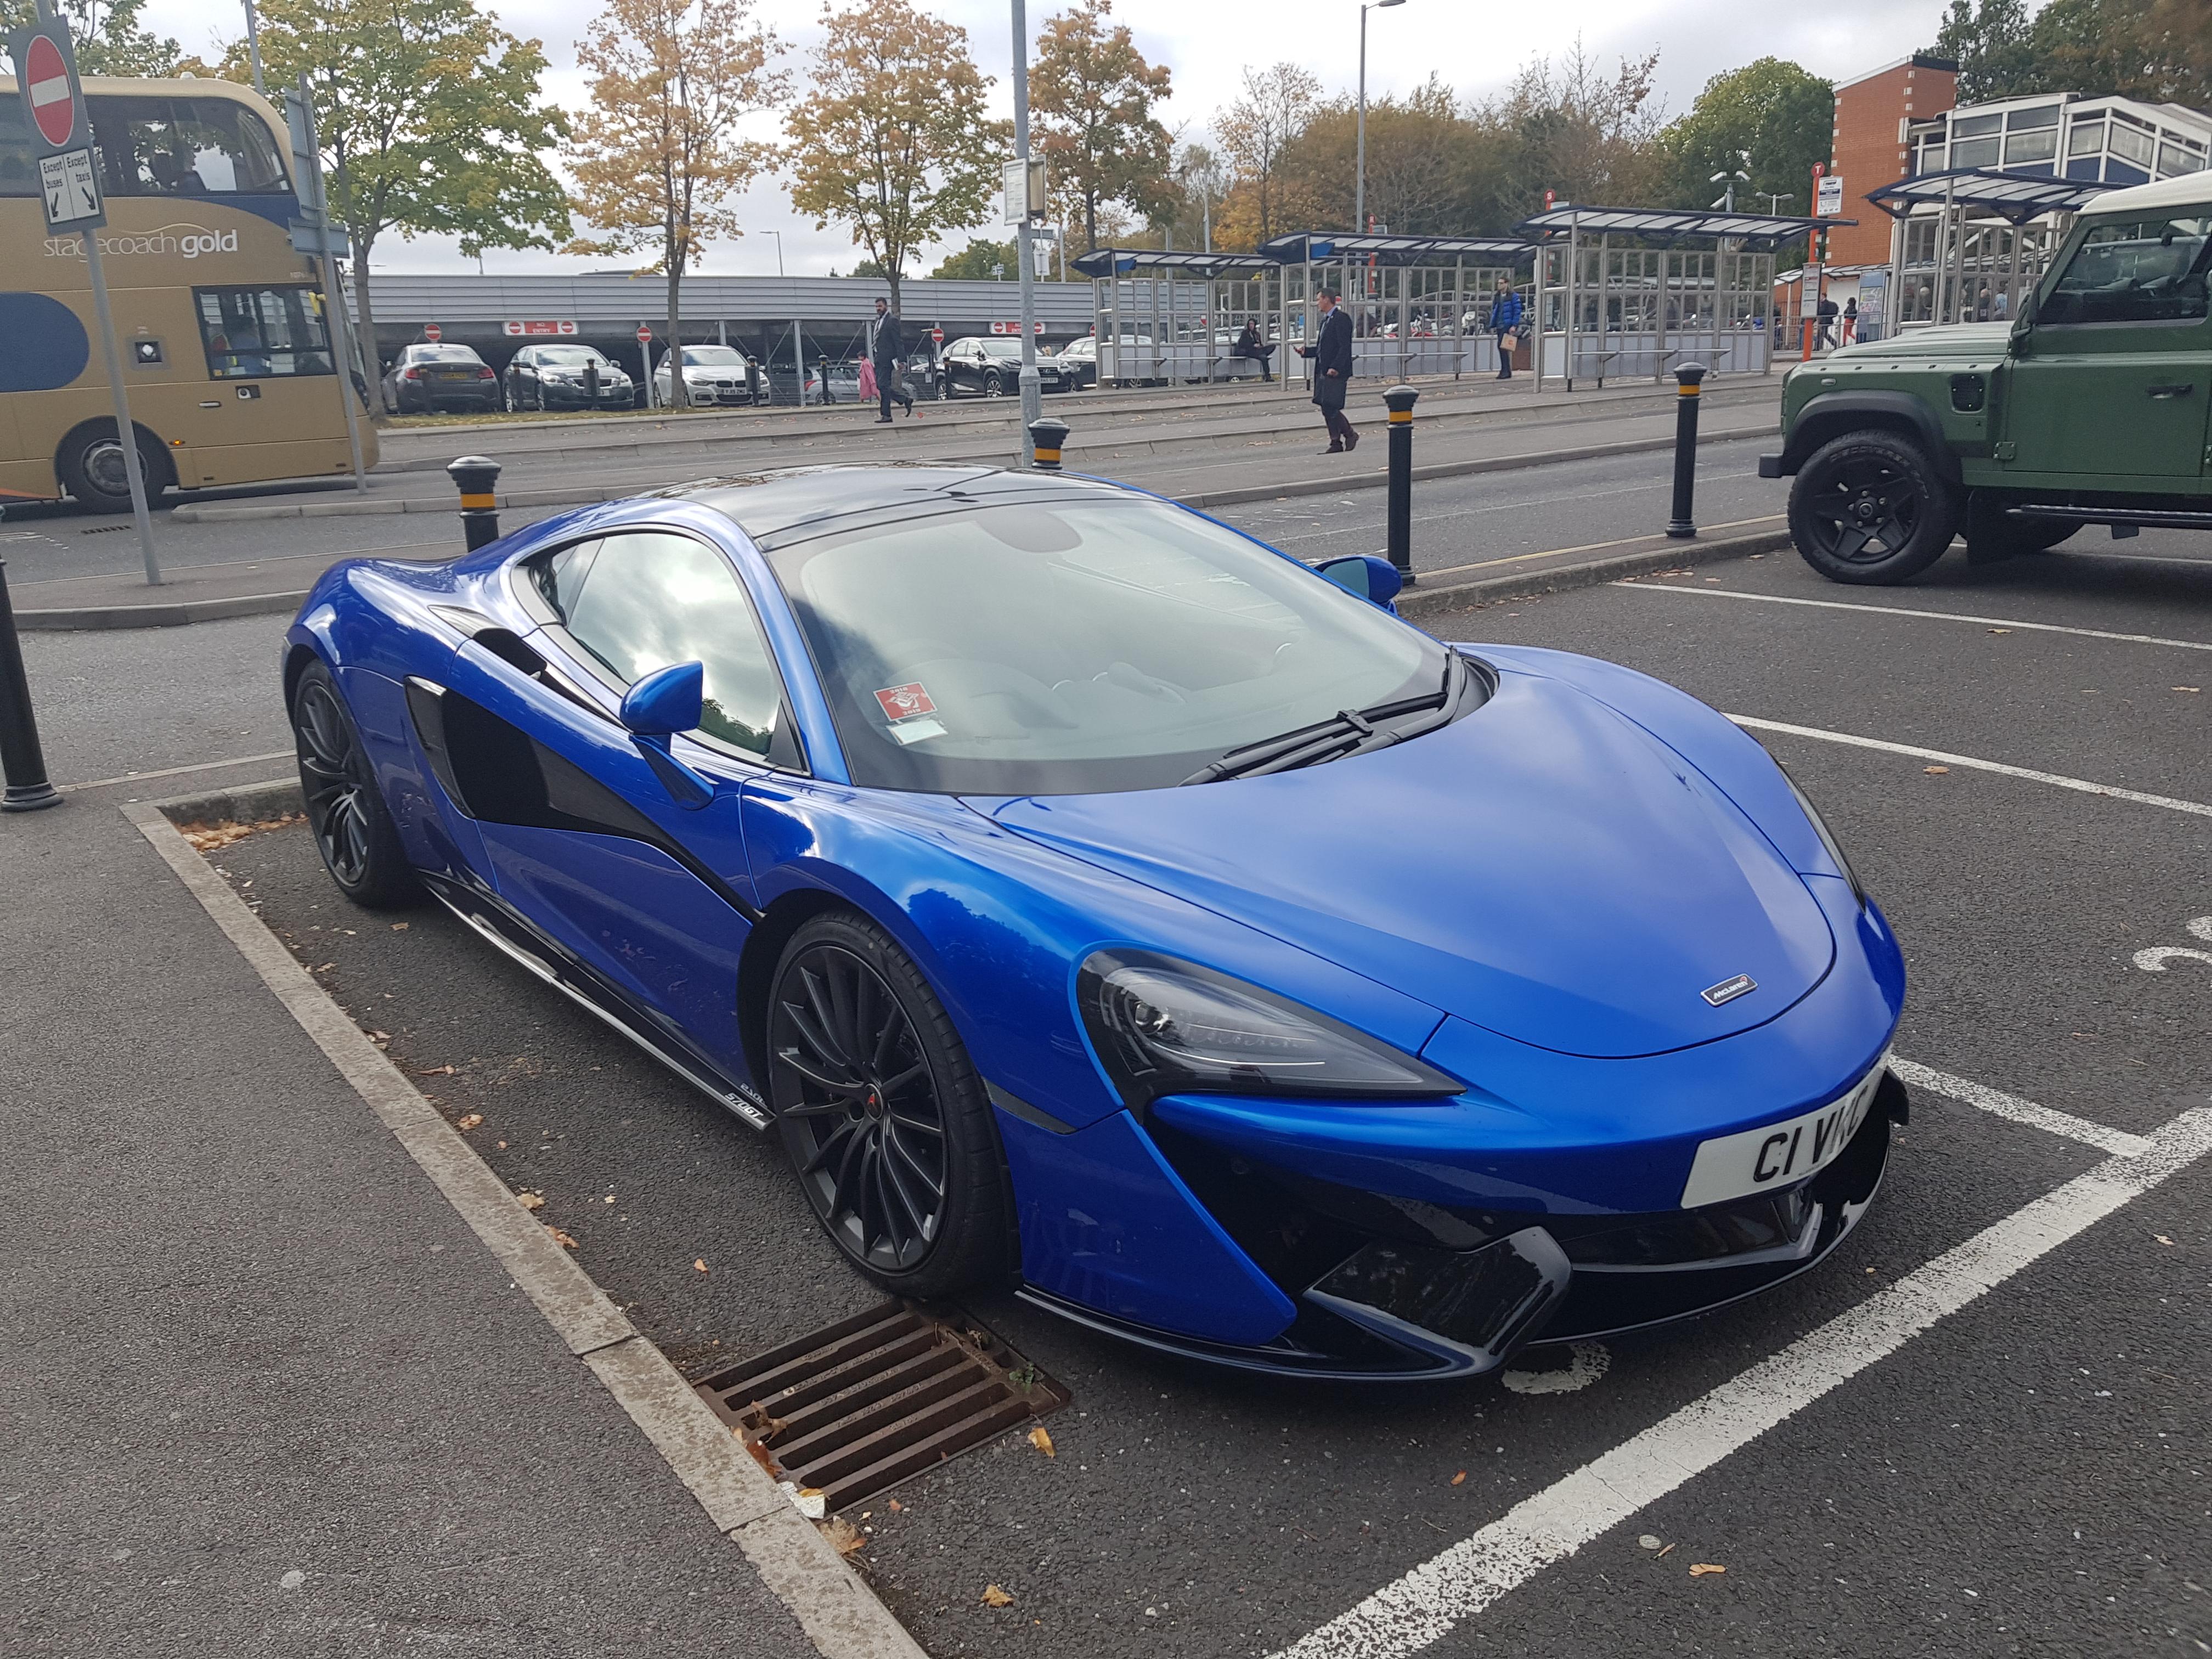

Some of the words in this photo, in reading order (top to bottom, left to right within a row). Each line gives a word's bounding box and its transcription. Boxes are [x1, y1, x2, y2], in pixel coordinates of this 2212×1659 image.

[43, 160, 63, 174] Except
[67, 154, 88, 168] Except
[1815, 165, 1822, 175] T
[46, 178, 63, 189] buses
[75, 172, 91, 183] taxis
[1547, 191, 1553, 200] S
[180, 228, 238, 259] gold
[1713, 980, 1748, 1000] McLaren
[724, 1092, 764, 1118] 570GT
